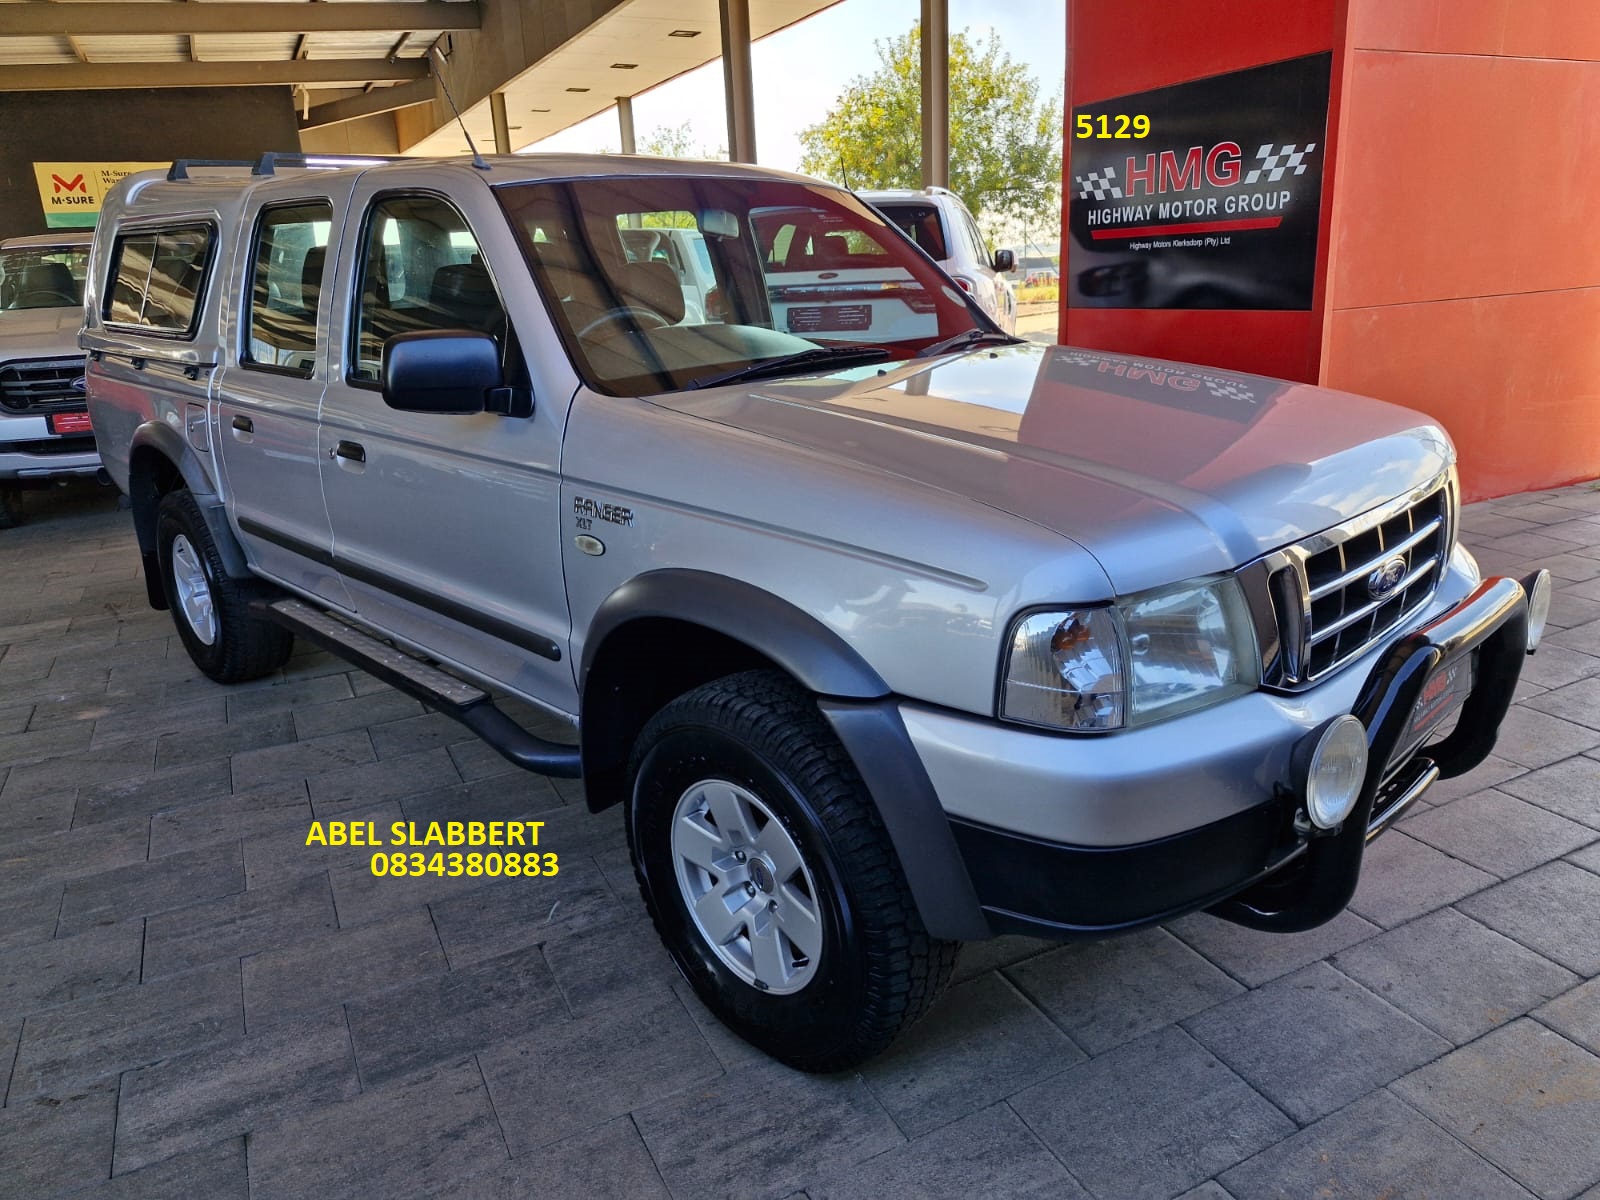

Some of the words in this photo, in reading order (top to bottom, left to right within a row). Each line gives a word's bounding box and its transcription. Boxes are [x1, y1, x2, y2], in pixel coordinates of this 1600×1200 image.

[1125, 141, 1241, 198] HMG
[1088, 204, 1153, 226] HIGHWAY
[1158, 198, 1217, 220] MOTOR
[1224, 191, 1291, 214] GROUP
[1129, 241, 1152, 250] Highway
[1152, 240, 1172, 249] Motors
[1204, 237, 1219, 247] (Pty)
[1220, 236, 1231, 245] Ltd
[574, 496, 634, 528] RANGER
